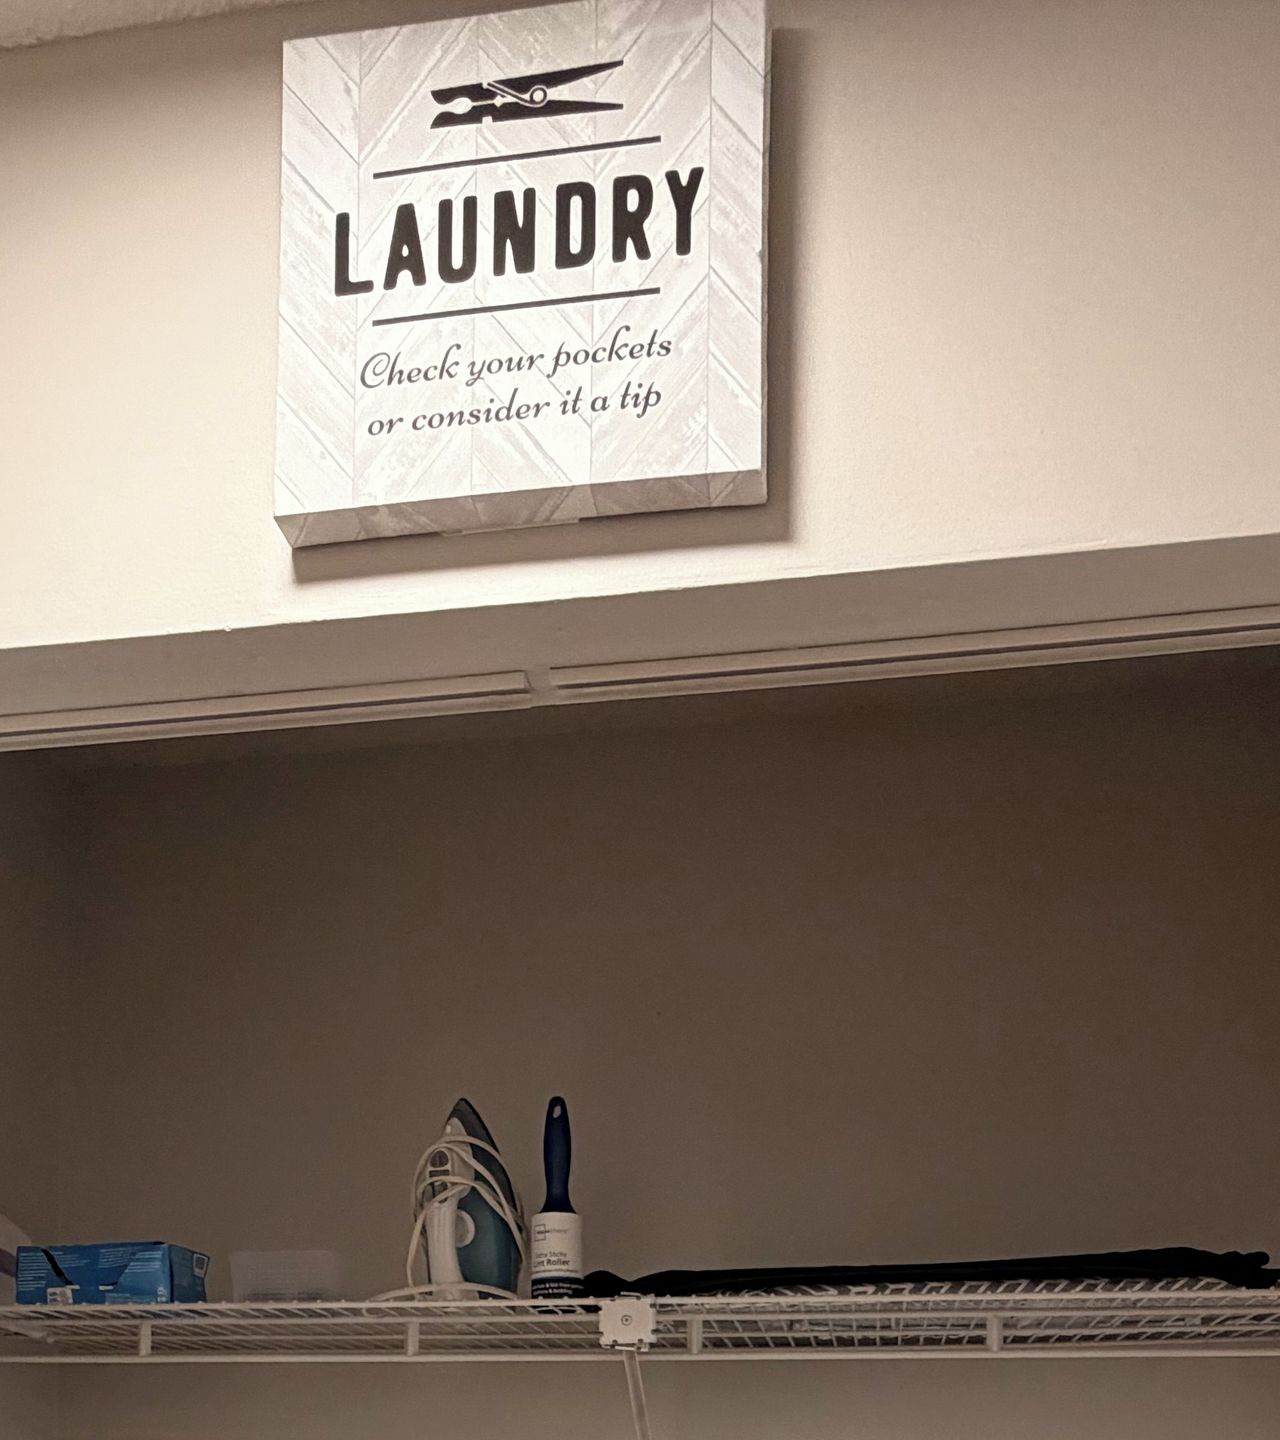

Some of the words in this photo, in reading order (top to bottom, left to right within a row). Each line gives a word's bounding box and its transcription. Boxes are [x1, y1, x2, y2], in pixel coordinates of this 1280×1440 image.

[335, 166, 704, 296] LAUNDRY
[360, 344, 461, 388] Check
[465, 354, 544, 387] your
[546, 325, 672, 378] pockets
[368, 416, 404, 436] or
[411, 388, 551, 431] consider
[560, 386, 583, 415] it
[590, 395, 610, 412] a
[620, 381, 662, 418] tip
[546, 1258, 570, 1266] Roller
